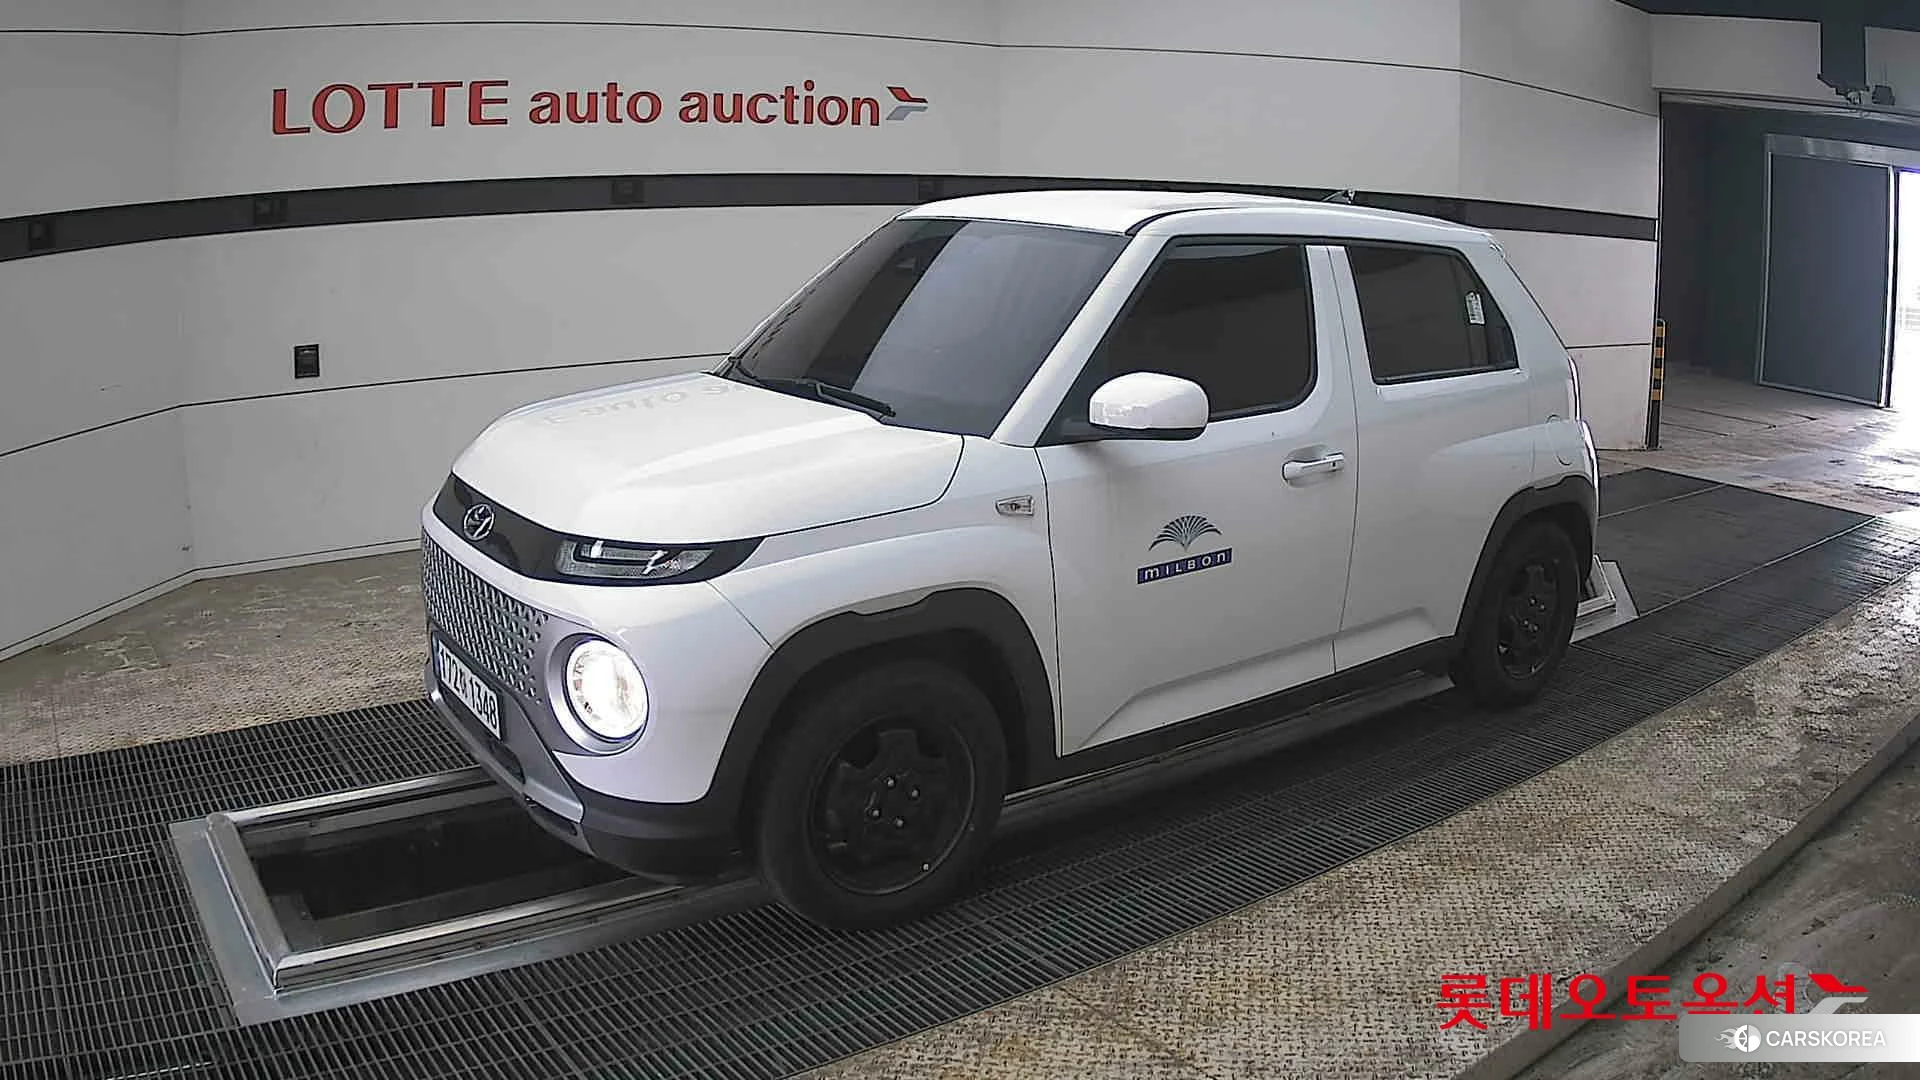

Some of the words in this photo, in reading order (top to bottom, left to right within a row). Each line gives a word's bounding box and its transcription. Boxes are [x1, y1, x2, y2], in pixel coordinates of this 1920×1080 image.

[273, 80, 509, 135] LOTTE
[529, 82, 662, 124] auto
[679, 80, 880, 126] auction
[470, 676, 497, 730] 1348
